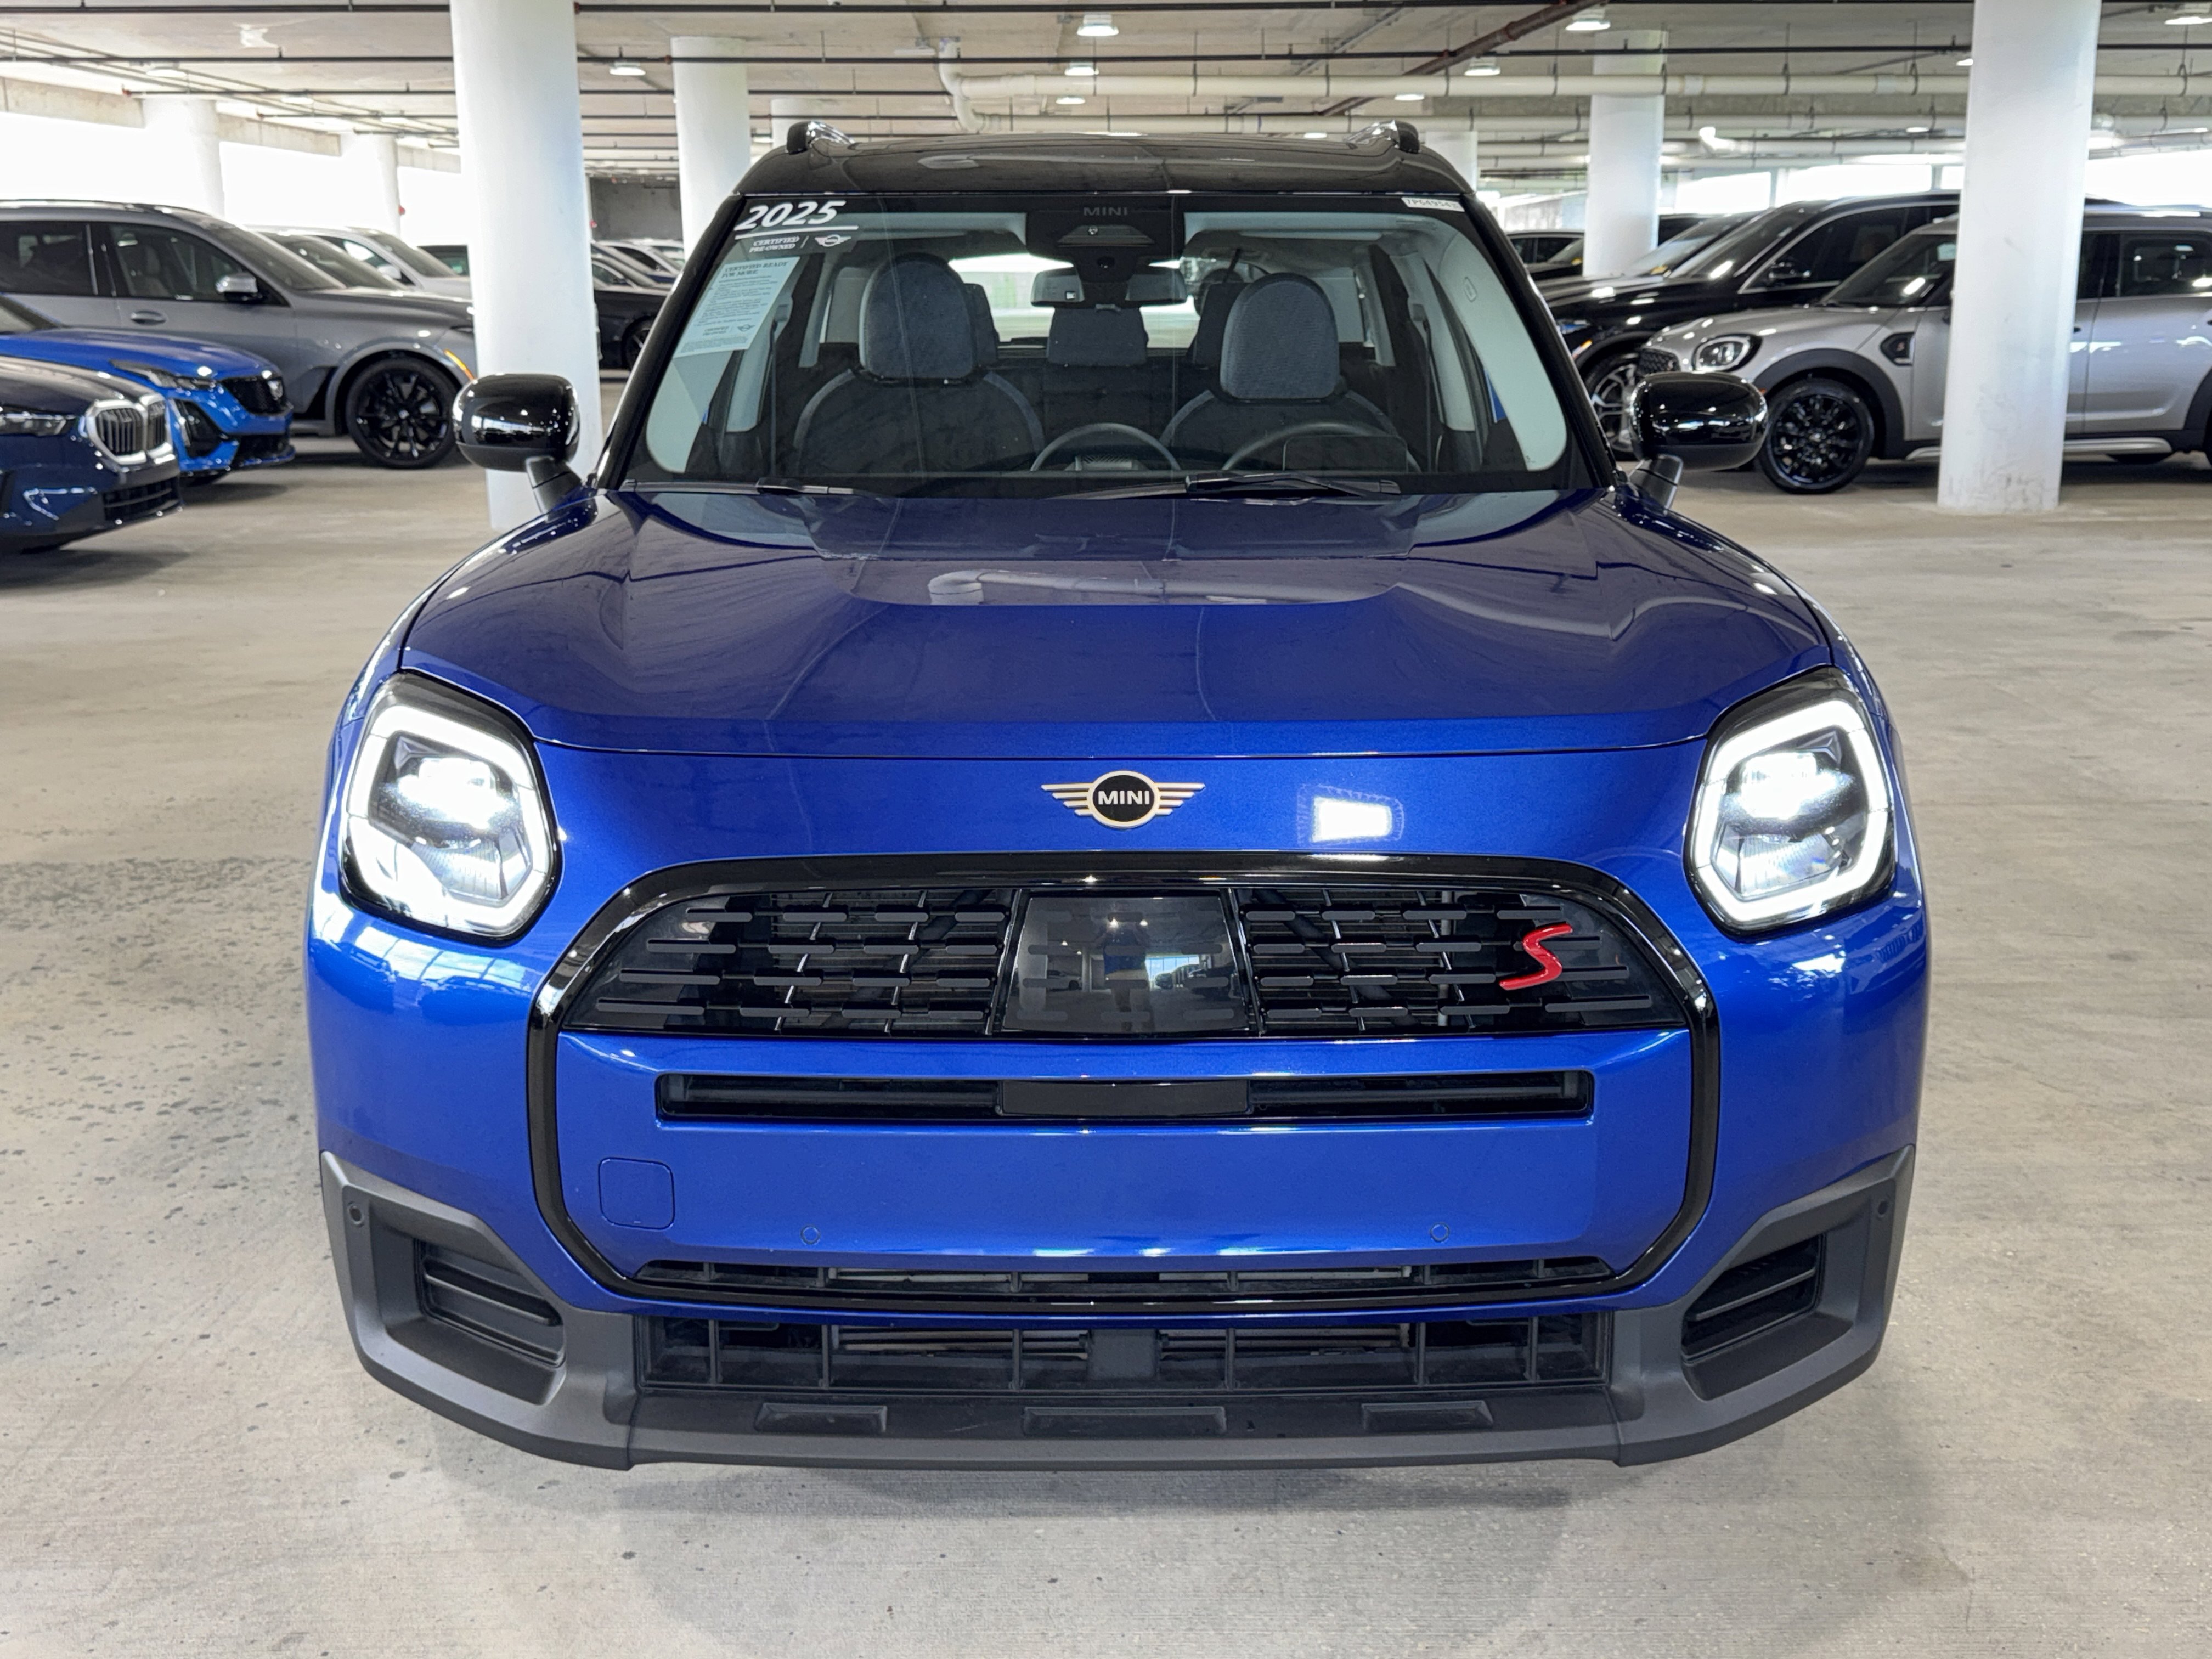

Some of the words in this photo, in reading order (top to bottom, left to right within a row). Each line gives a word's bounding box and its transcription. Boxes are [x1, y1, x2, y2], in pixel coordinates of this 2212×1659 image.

[733, 200, 847, 231] 2025
[1084, 207, 1128, 216] MINI
[753, 236, 800, 246] CERTIFIED
[749, 243, 796, 253] PRE-OWNED
[1098, 790, 1150, 805] MINI
[1499, 921, 1573, 991] S
